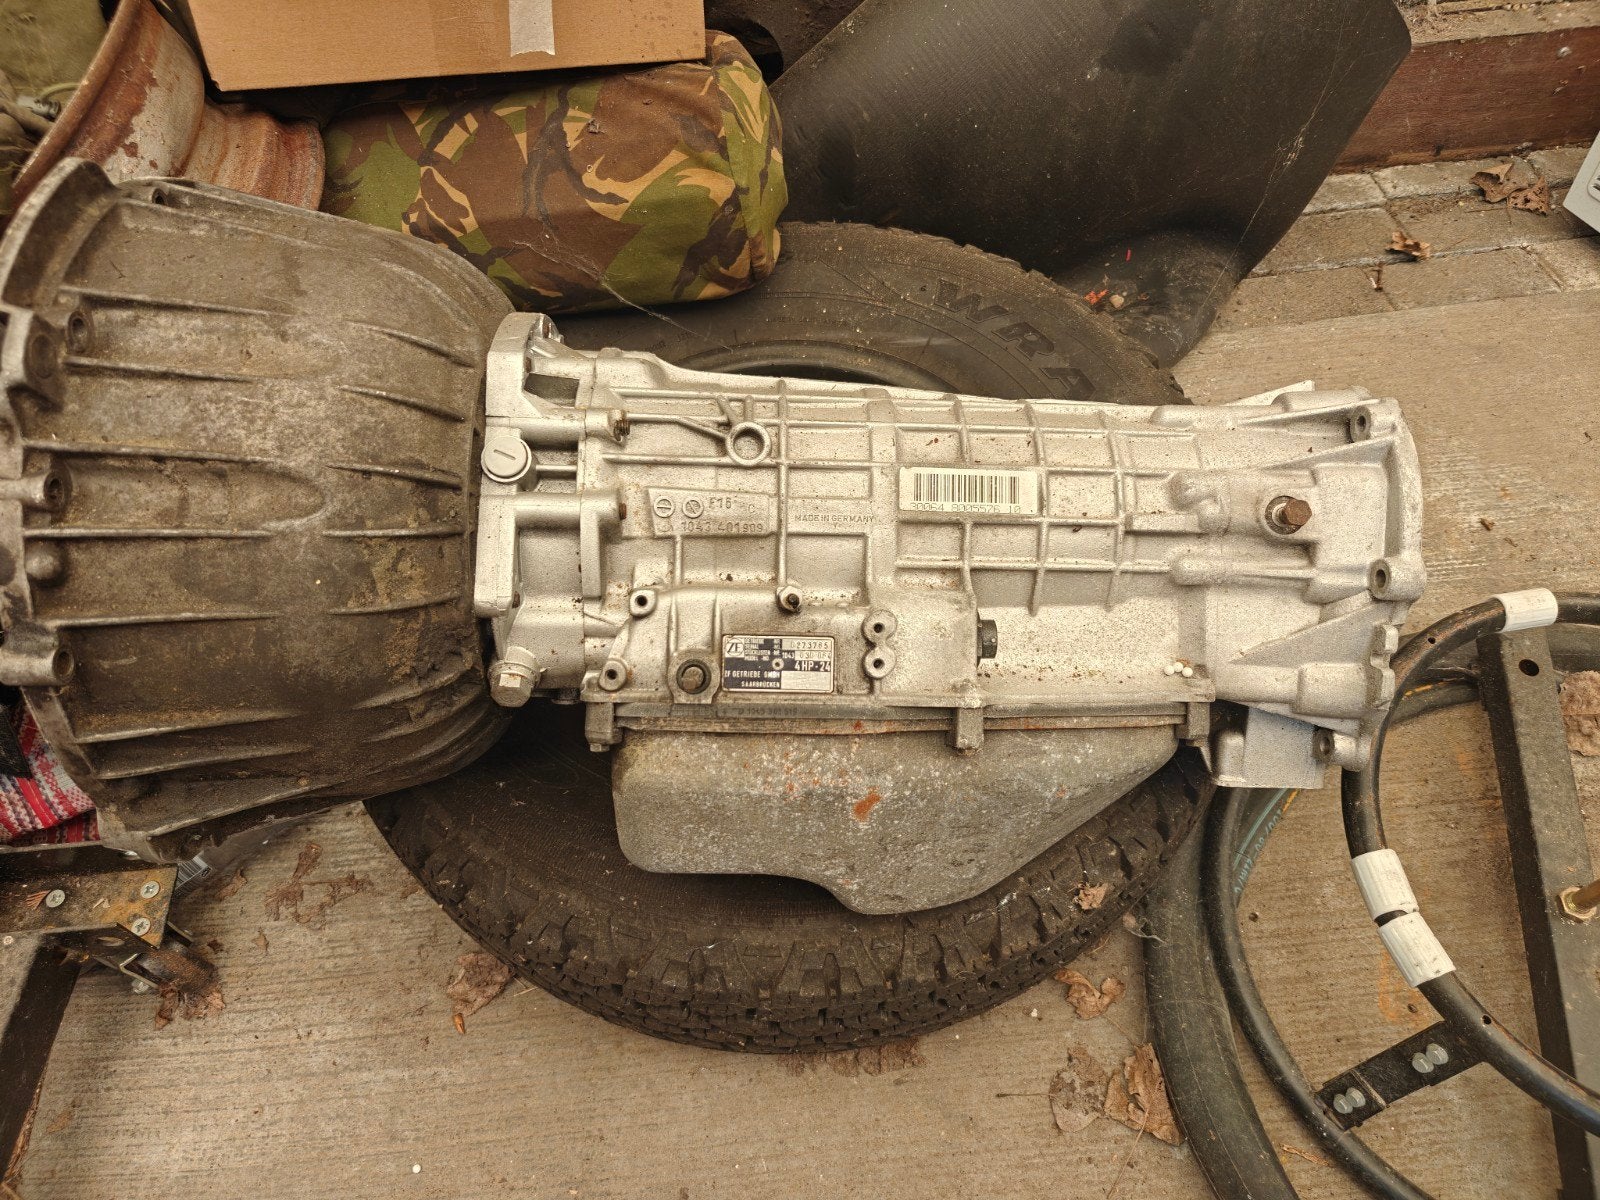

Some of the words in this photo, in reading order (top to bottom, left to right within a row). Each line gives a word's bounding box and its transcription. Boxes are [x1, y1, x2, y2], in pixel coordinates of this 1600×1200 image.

[794, 514, 820, 522] MADE
[820, 514, 830, 522] IN
[831, 514, 874, 523] GERMANY
[732, 670, 761, 678] GETRIEBE
